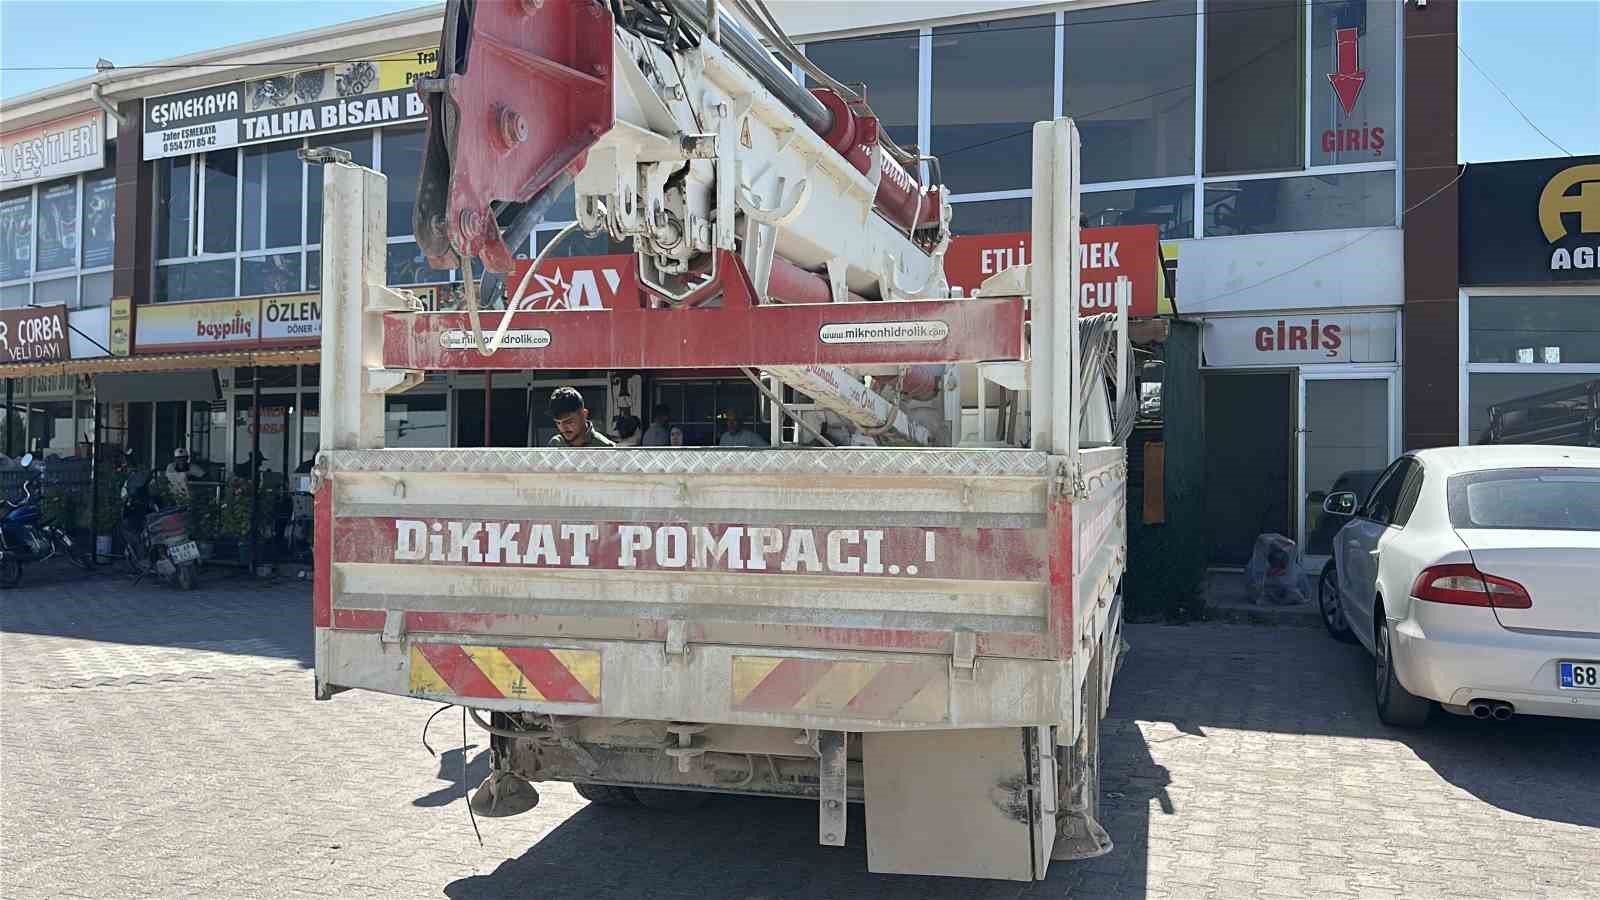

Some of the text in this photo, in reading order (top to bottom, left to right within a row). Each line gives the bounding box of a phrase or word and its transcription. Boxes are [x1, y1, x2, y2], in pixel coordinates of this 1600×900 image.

[151, 91, 239, 128] EŞMEKAYA
[243, 108, 316, 140] TALHA
[321, 95, 399, 128] BİSAN
[12, 116, 98, 177] ÇEŞİTLERİ
[163, 143, 168, 153] 0
[181, 125, 217, 140] EŞMEKAYA
[1321, 122, 1385, 156] GİRİŞ
[981, 241, 1025, 273] ETLİ
[1551, 246, 1600, 269] AG
[18, 314, 64, 346] ÇORBA
[1255, 319, 1342, 357] GİRİŞ
[35, 342, 61, 359] DAYI
[1573, 666, 1596, 686] 68
